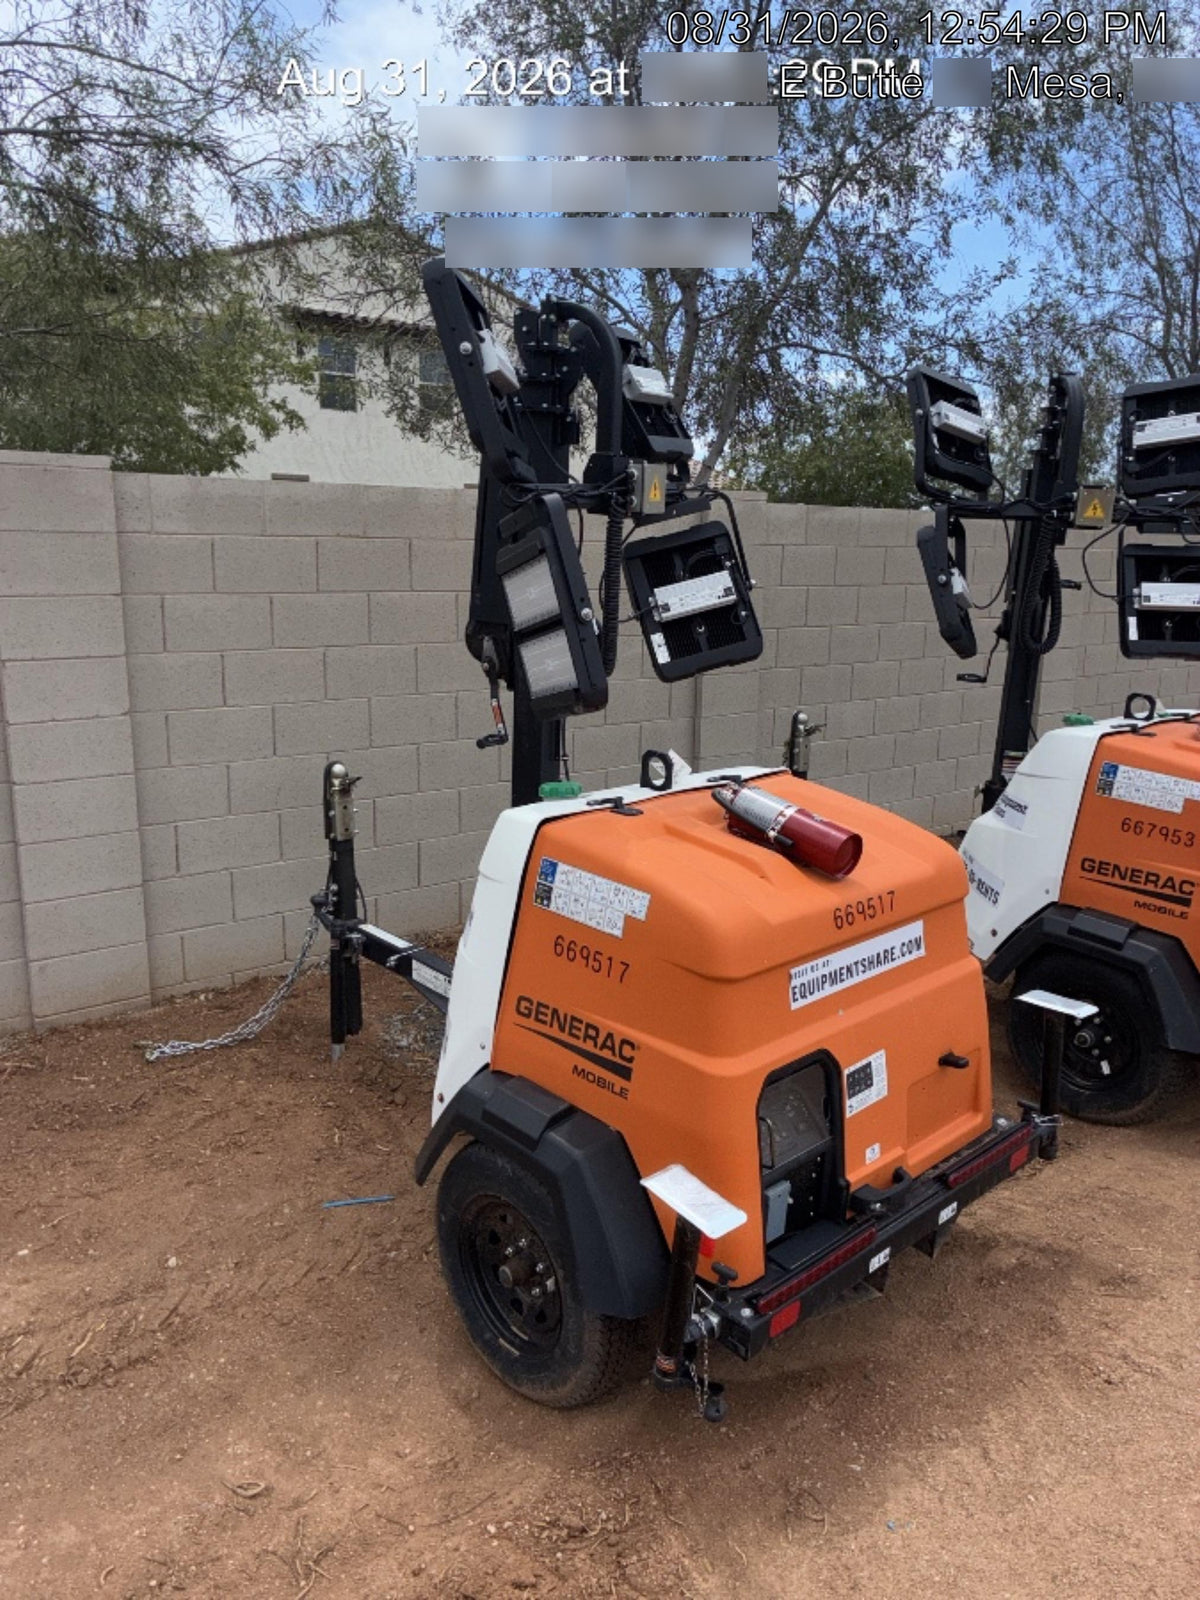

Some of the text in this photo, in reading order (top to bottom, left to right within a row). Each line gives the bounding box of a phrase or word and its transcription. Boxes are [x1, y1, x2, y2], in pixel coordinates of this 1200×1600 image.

[1120, 817, 1196, 848] 667953
[1080, 857, 1196, 896] GENERAC
[833, 890, 896, 930] 669517
[1133, 899, 1189, 920] MOBILE
[553, 935, 630, 983] 669517
[791, 935, 922, 1004] EQUIPMENTSHARE.COM
[515, 995, 636, 1063] GENERAC
[572, 1063, 630, 1100] MOBILE
